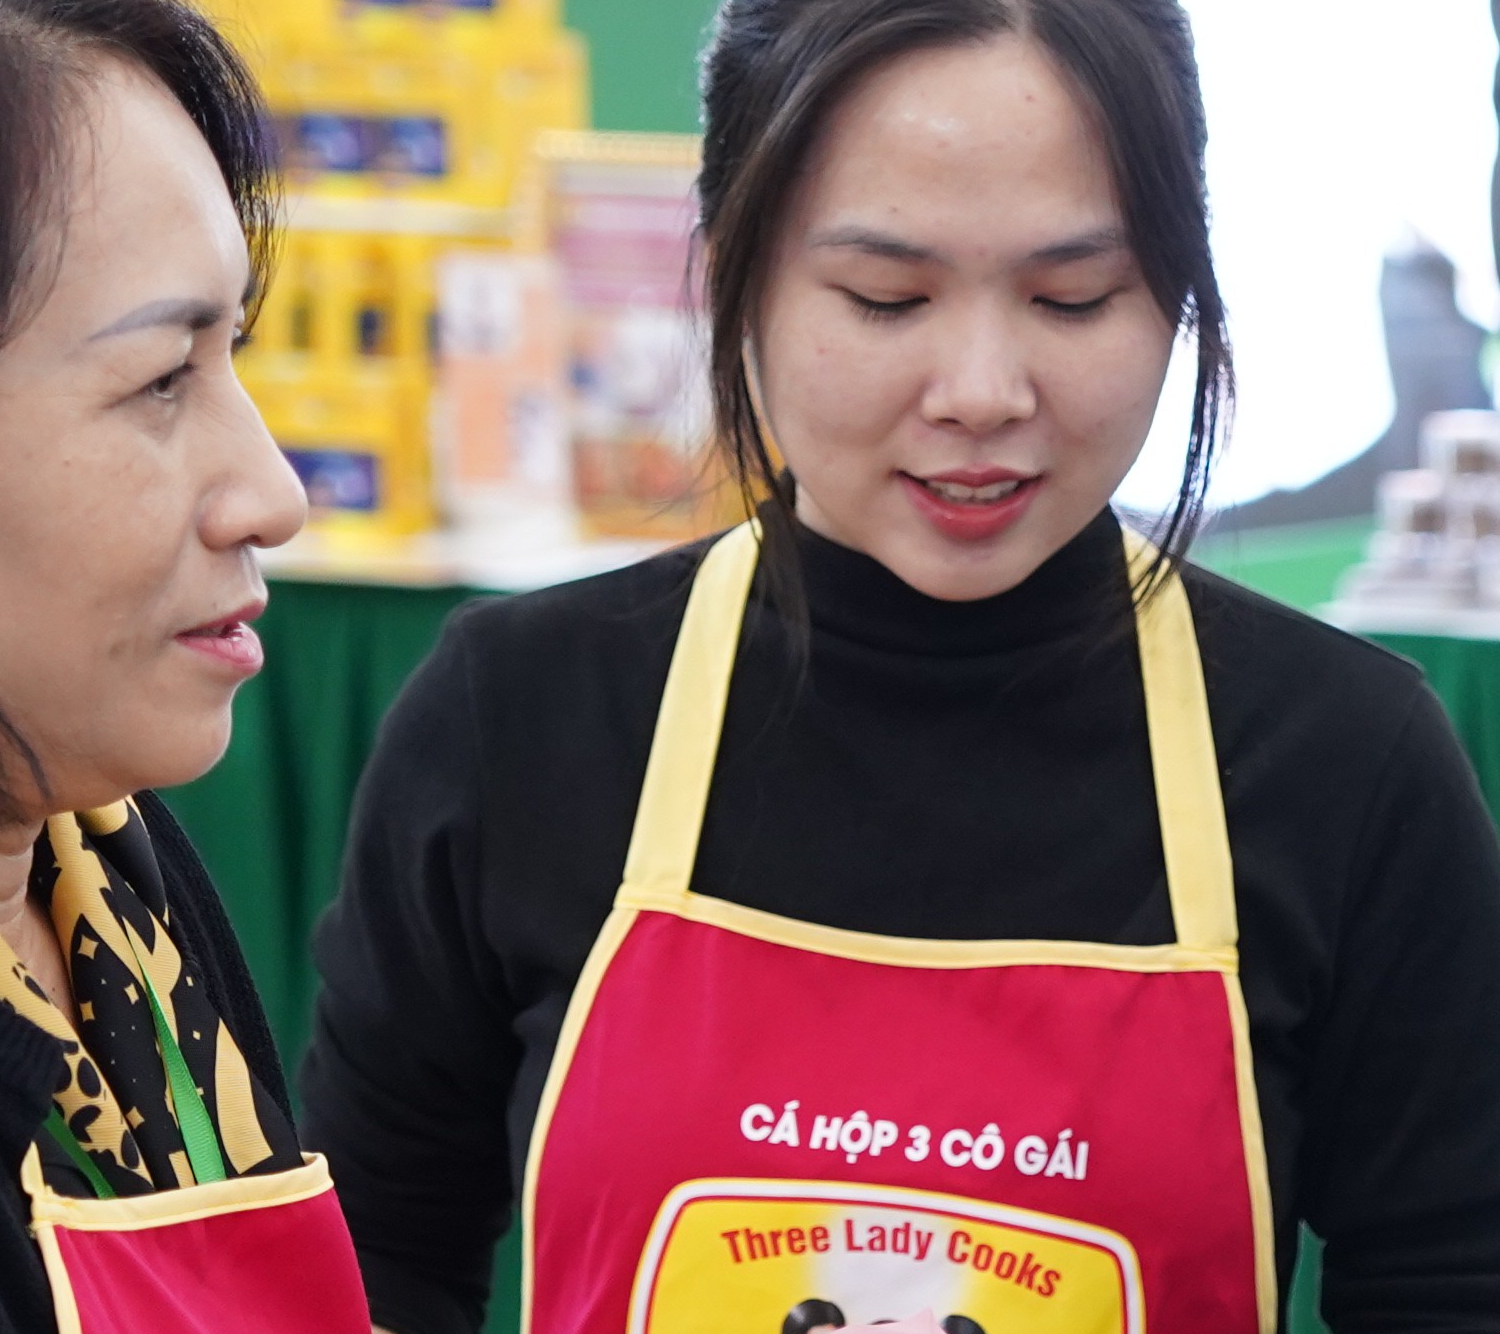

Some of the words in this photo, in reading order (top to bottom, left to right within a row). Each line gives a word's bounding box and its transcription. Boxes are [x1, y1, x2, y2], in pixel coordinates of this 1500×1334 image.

[740, 1099, 800, 1147] CÁ
[809, 1110, 899, 1164] HỘP
[904, 1125, 931, 1162] 3
[940, 1123, 1005, 1170] CÔ
[1014, 1128, 1089, 1180] GÁI
[721, 1225, 832, 1264] Three
[844, 1219, 933, 1261] Lady
[947, 1230, 1062, 1298] Cooks
